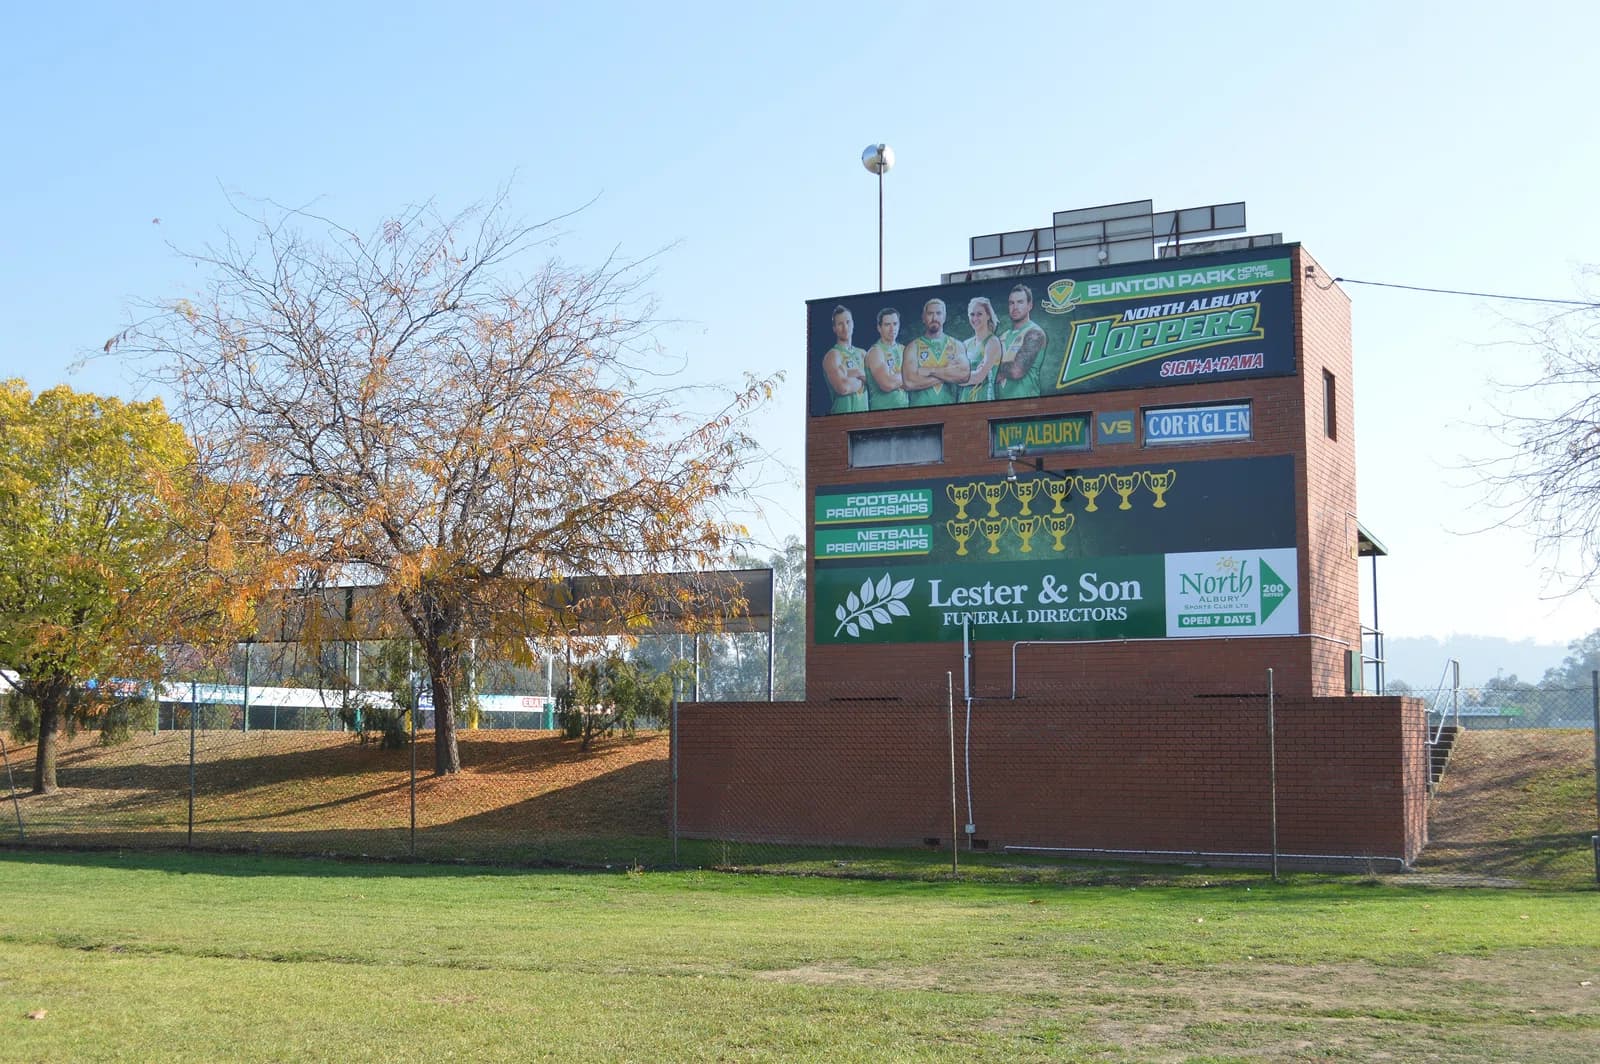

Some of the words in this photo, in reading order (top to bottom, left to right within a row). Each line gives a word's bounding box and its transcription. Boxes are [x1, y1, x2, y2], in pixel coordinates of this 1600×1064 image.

[1237, 264, 1268, 274] HOME
[1237, 272, 1251, 281] OF
[1087, 274, 1176, 297] BUNTON
[1178, 268, 1236, 287] PARK
[1122, 300, 1187, 322] NORTH
[1187, 289, 1263, 315] ALBURY
[1064, 308, 1258, 376] HOPPERS
[1025, 421, 1082, 445] ALBURY
[1100, 420, 1132, 435] VS
[955, 488, 969, 500] 46
[986, 486, 1000, 498] 48
[1018, 485, 1032, 496] 55
[1051, 483, 1065, 495] 80
[1084, 481, 1098, 493] 84
[1117, 479, 1132, 490] 99
[1152, 476, 1167, 488] 02
[846, 492, 928, 507] FOOTBALL
[826, 503, 928, 519] PREMIERSHIPS
[857, 527, 928, 541] NETBALL
[955, 524, 969, 536] 96
[986, 523, 1000, 535] 99
[1019, 522, 1032, 533] 07
[1052, 520, 1065, 531] 08
[826, 538, 928, 553] PREMIERSHIPS
[1179, 560, 1253, 597] North
[928, 579, 1028, 607] Lester
[1038, 574, 1068, 604] &
[1079, 572, 1143, 602] Son
[1262, 584, 1284, 593] 200
[1198, 595, 1240, 603] ALBURY
[943, 609, 1023, 626] FUNERAL
[1027, 606, 1127, 623] DIRECTORS
[1182, 615, 1211, 625] OPEN
[1213, 615, 1220, 624] 7
[1223, 615, 1252, 624] DAYS
